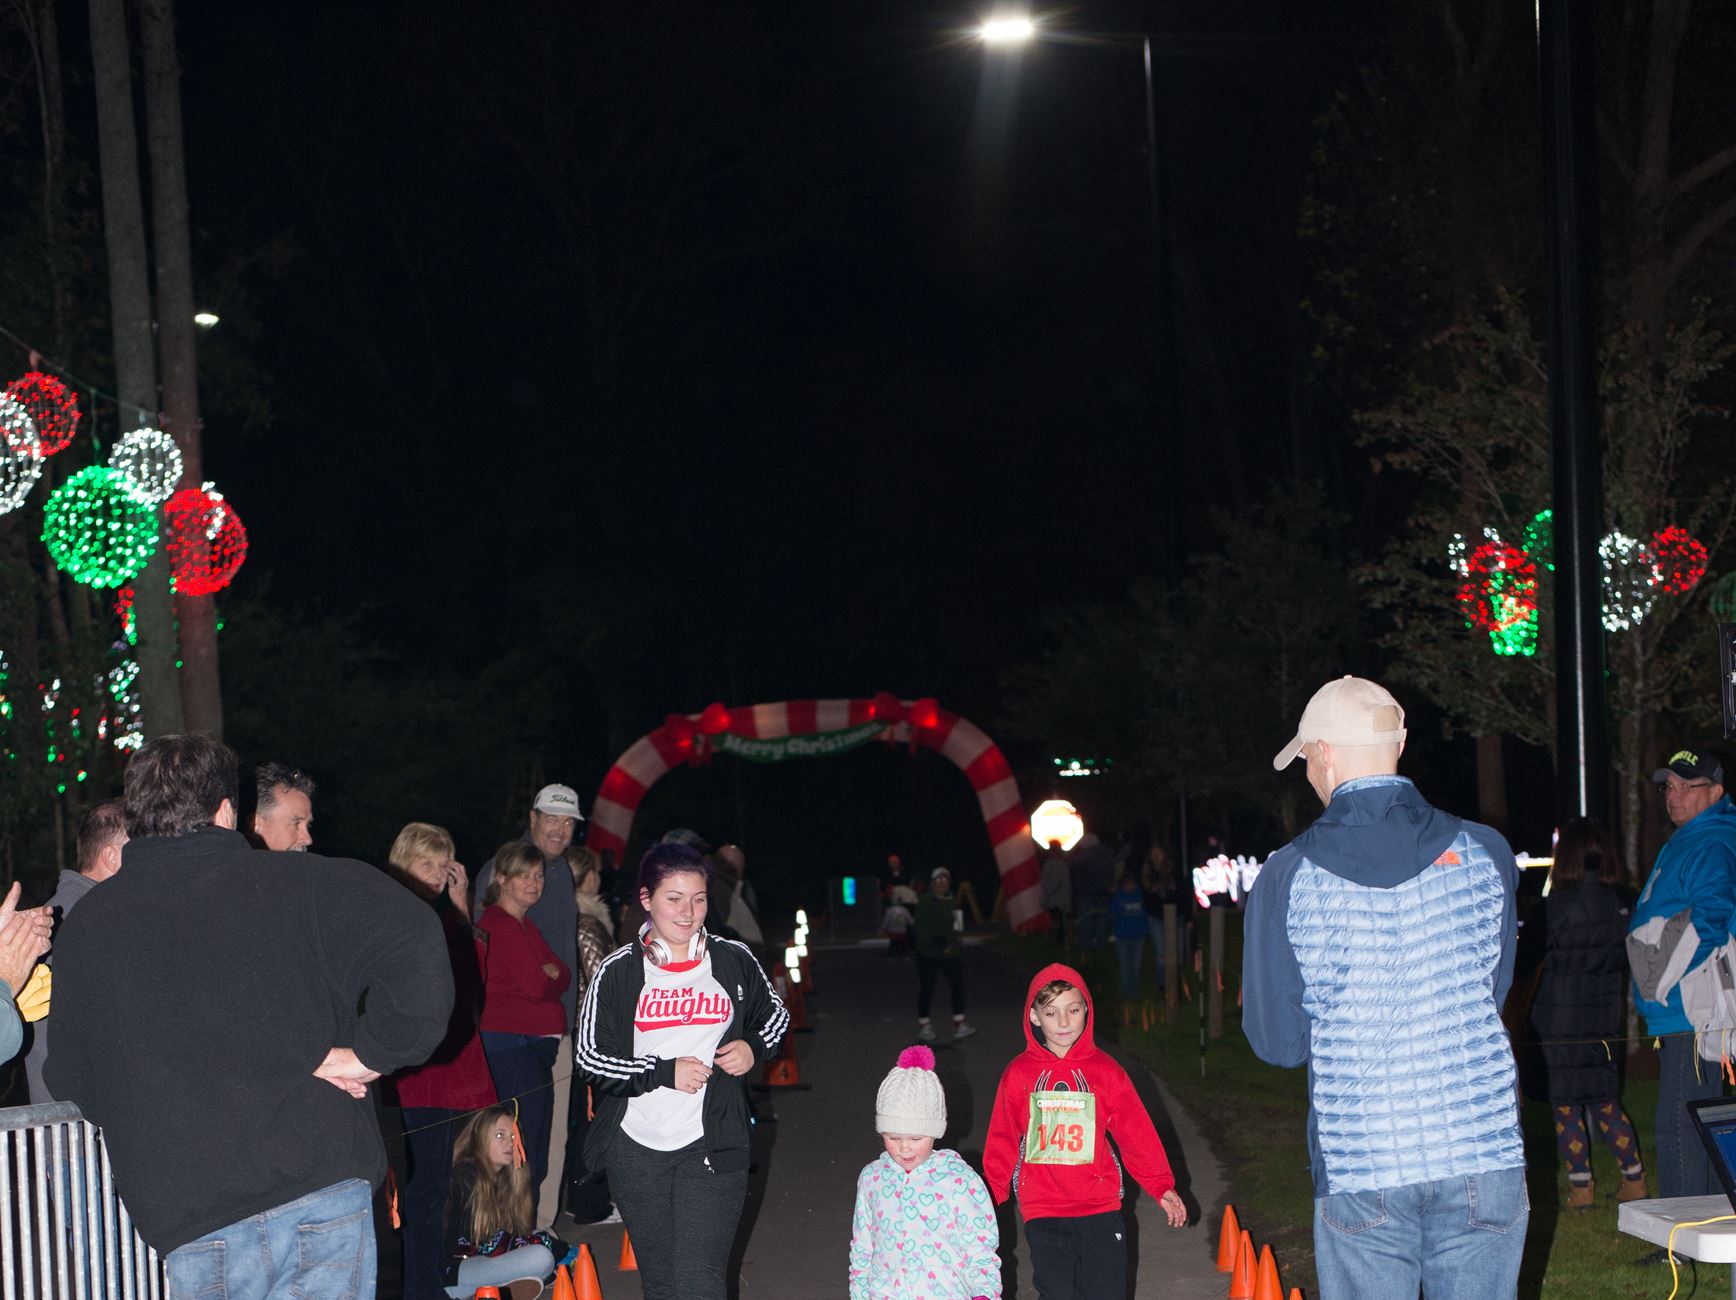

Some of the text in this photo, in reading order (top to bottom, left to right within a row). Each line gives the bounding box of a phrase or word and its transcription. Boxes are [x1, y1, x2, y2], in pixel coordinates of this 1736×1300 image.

[724, 735, 784, 760] Merry
[651, 987, 694, 999] TEAM
[637, 992, 730, 1023] Naughty
[1037, 1124, 1084, 1152] 143
